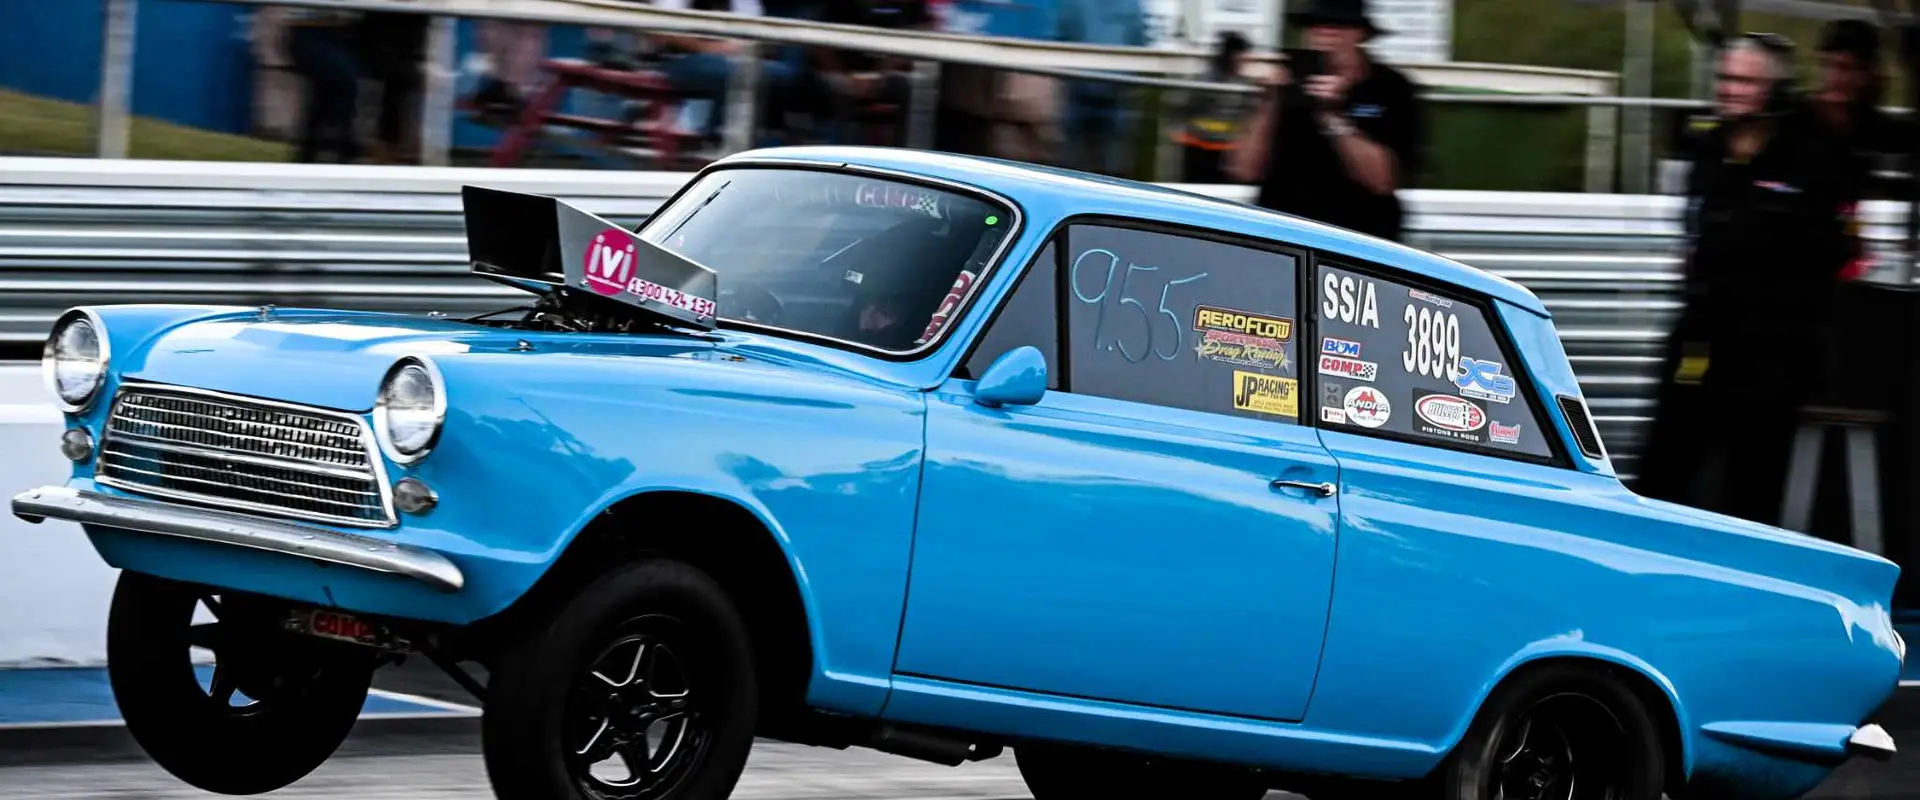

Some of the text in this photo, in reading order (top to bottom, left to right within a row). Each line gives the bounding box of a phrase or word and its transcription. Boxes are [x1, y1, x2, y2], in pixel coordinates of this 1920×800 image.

[588, 234, 634, 282] ivi
[631, 279, 714, 316] 1300 424 131
[1072, 248, 1208, 363] 9.55
[1323, 272, 1379, 329] SS/A
[1198, 309, 1290, 339] AEROFLOW
[1403, 304, 1459, 382] 3899
[1321, 357, 1364, 373] COMP
[1236, 375, 1258, 407] JP
[1257, 379, 1290, 396] RACING
[1346, 397, 1390, 414] ANDRA
[1422, 426, 1451, 436] PISTONS
